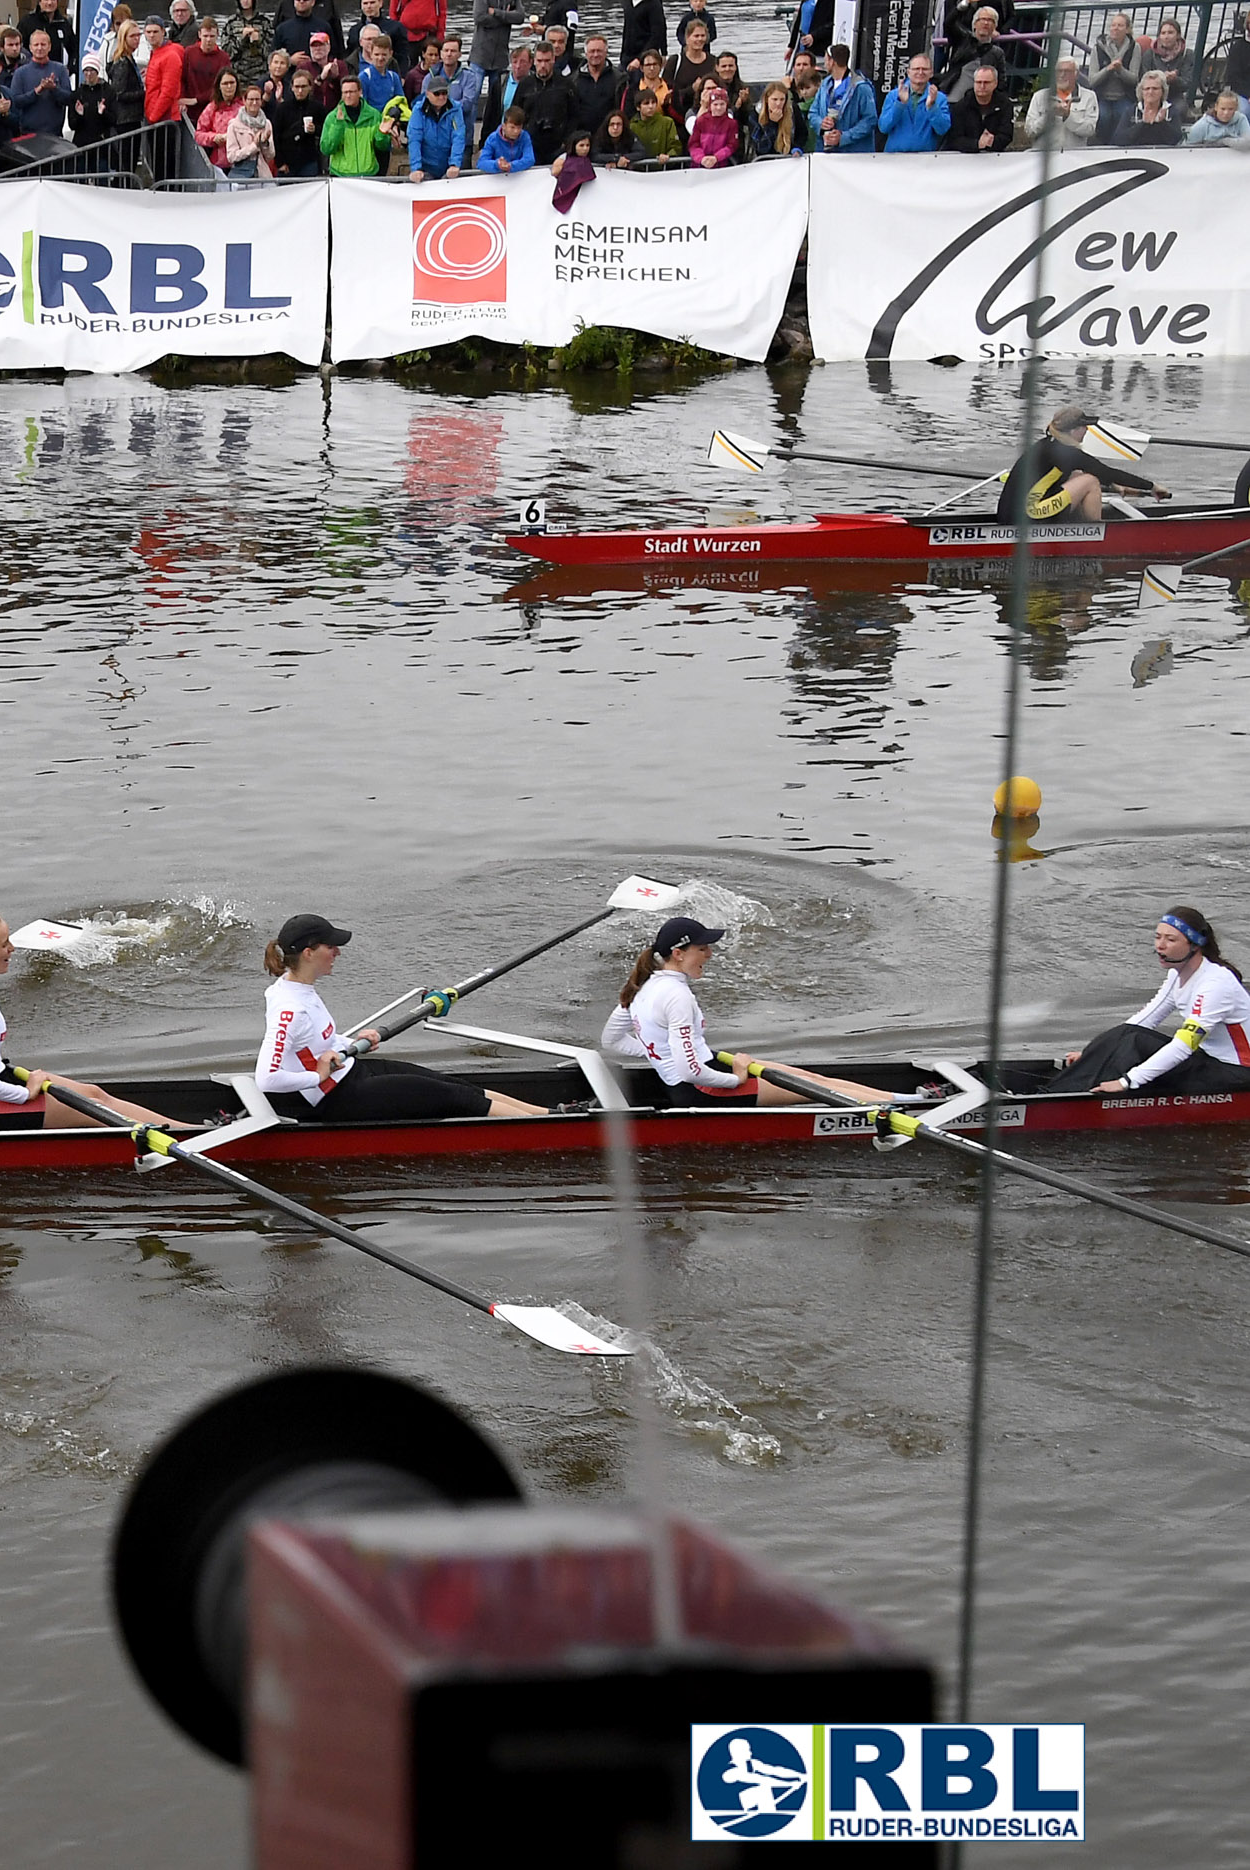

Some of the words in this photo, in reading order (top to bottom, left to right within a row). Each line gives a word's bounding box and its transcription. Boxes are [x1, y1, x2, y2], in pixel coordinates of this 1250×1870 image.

[888, 0, 901, 33] Event
[898, 0, 914, 48] ineering
[881, 34, 898, 92] Marketing
[556, 222, 707, 243] GEMEINSAM
[555, 244, 624, 264] MEHR
[38, 235, 292, 315] RBL
[555, 264, 697, 283] ERREICHEN.
[40, 311, 291, 333] RUDER-BUNDESLIGA
[525, 500, 540, 523] 6
[952, 527, 987, 540] RBL
[991, 526, 1101, 540] RUDEBUNDESLIGA
[644, 537, 689, 554] Stadt
[693, 537, 761, 553] Wurzen
[268, 1010, 294, 1073] Bremen
[679, 1025, 702, 1076] Bremen
[1102, 1098, 1154, 1109] BREMER
[1157, 1097, 1170, 1107] R.
[1173, 1096, 1185, 1106] C.
[1189, 1094, 1233, 1105] HANSA
[838, 1115, 875, 1128] RBL
